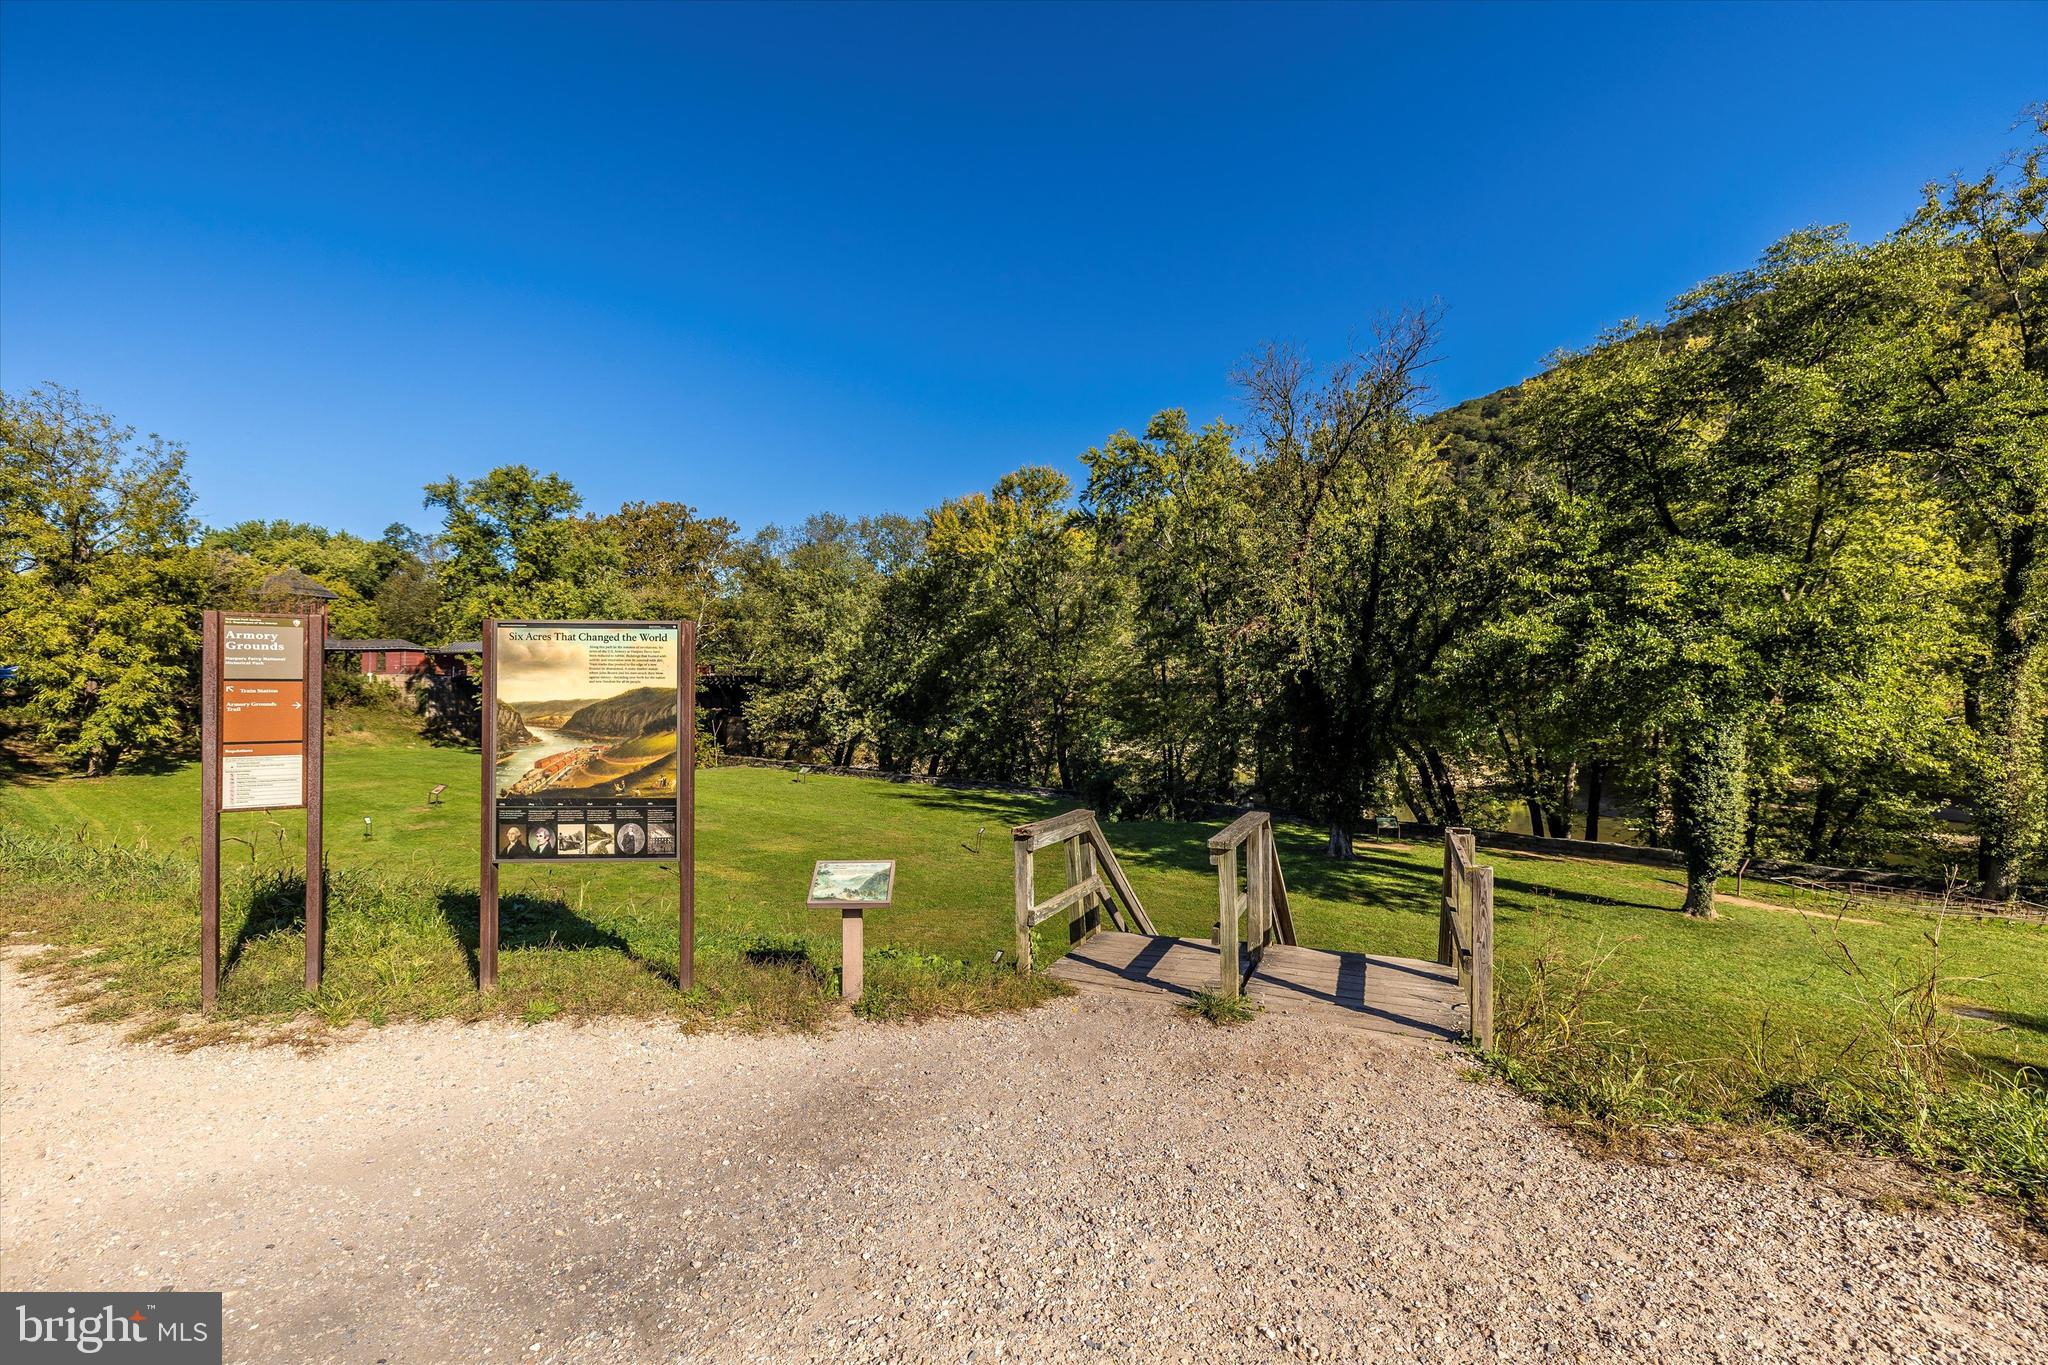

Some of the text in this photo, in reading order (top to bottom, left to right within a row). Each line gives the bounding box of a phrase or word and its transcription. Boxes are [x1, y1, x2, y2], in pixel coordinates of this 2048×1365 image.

[225, 630, 278, 642] Armory
[509, 632, 668, 643] Six Acres That Changed the World
[225, 641, 285, 651] Grounds
